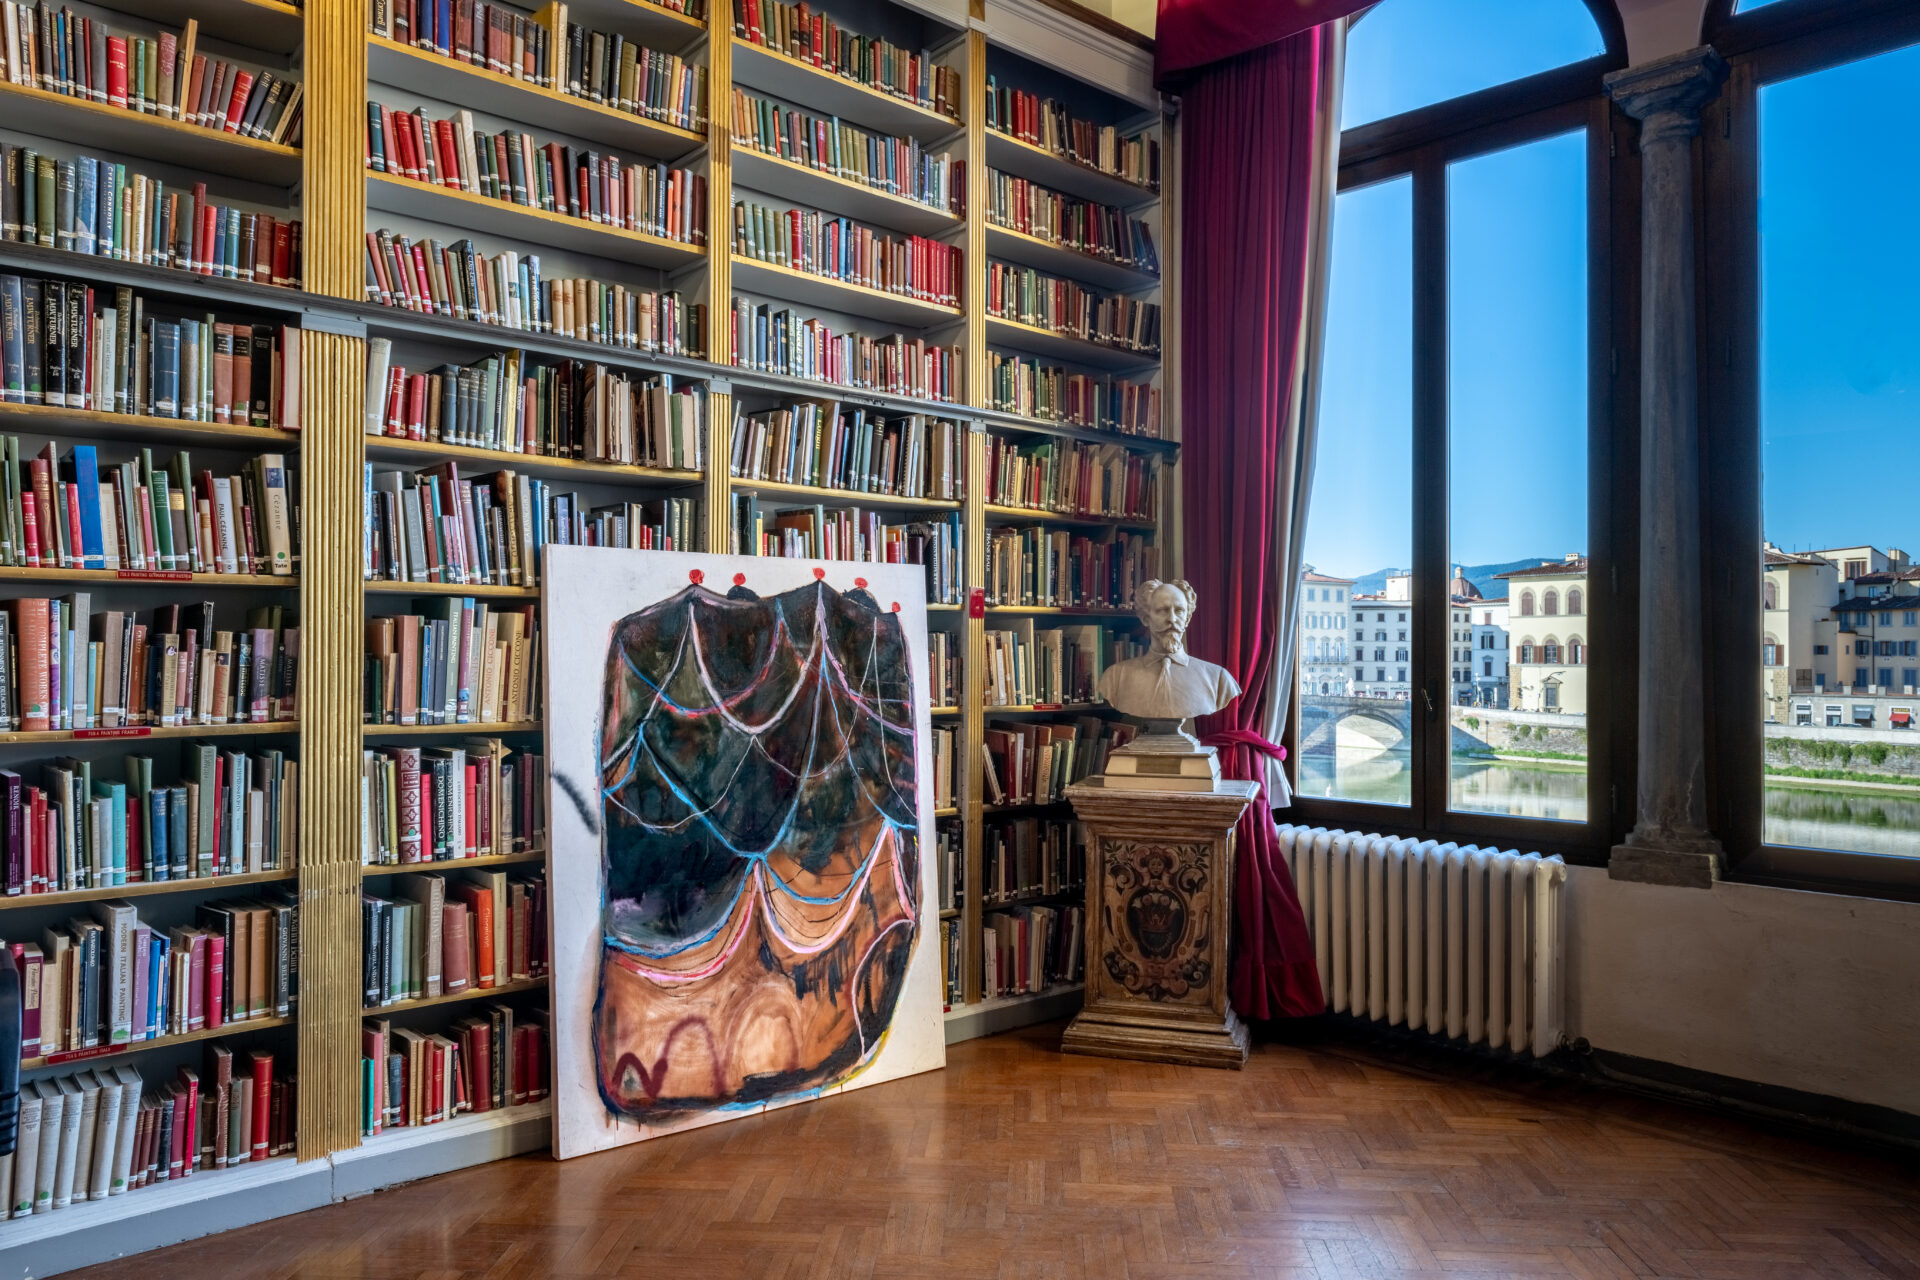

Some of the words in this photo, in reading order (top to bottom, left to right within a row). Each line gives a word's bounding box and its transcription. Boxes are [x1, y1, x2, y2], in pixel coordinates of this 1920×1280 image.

[118, 291, 130, 333] TURNER
[27, 316, 35, 344] TURNER
[70, 320, 78, 348] TURNER
[220, 521, 228, 550] CÉZANNE
[38, 626, 48, 669] COMPLETE
[484, 666, 492, 705] ANTONIO
[488, 628, 496, 664] CICCONE
[40, 671, 48, 699] WORKS
[512, 666, 520, 705] ANTONIO
[120, 956, 128, 984] ITALIAN
[118, 988, 126, 1022] PAINTING
